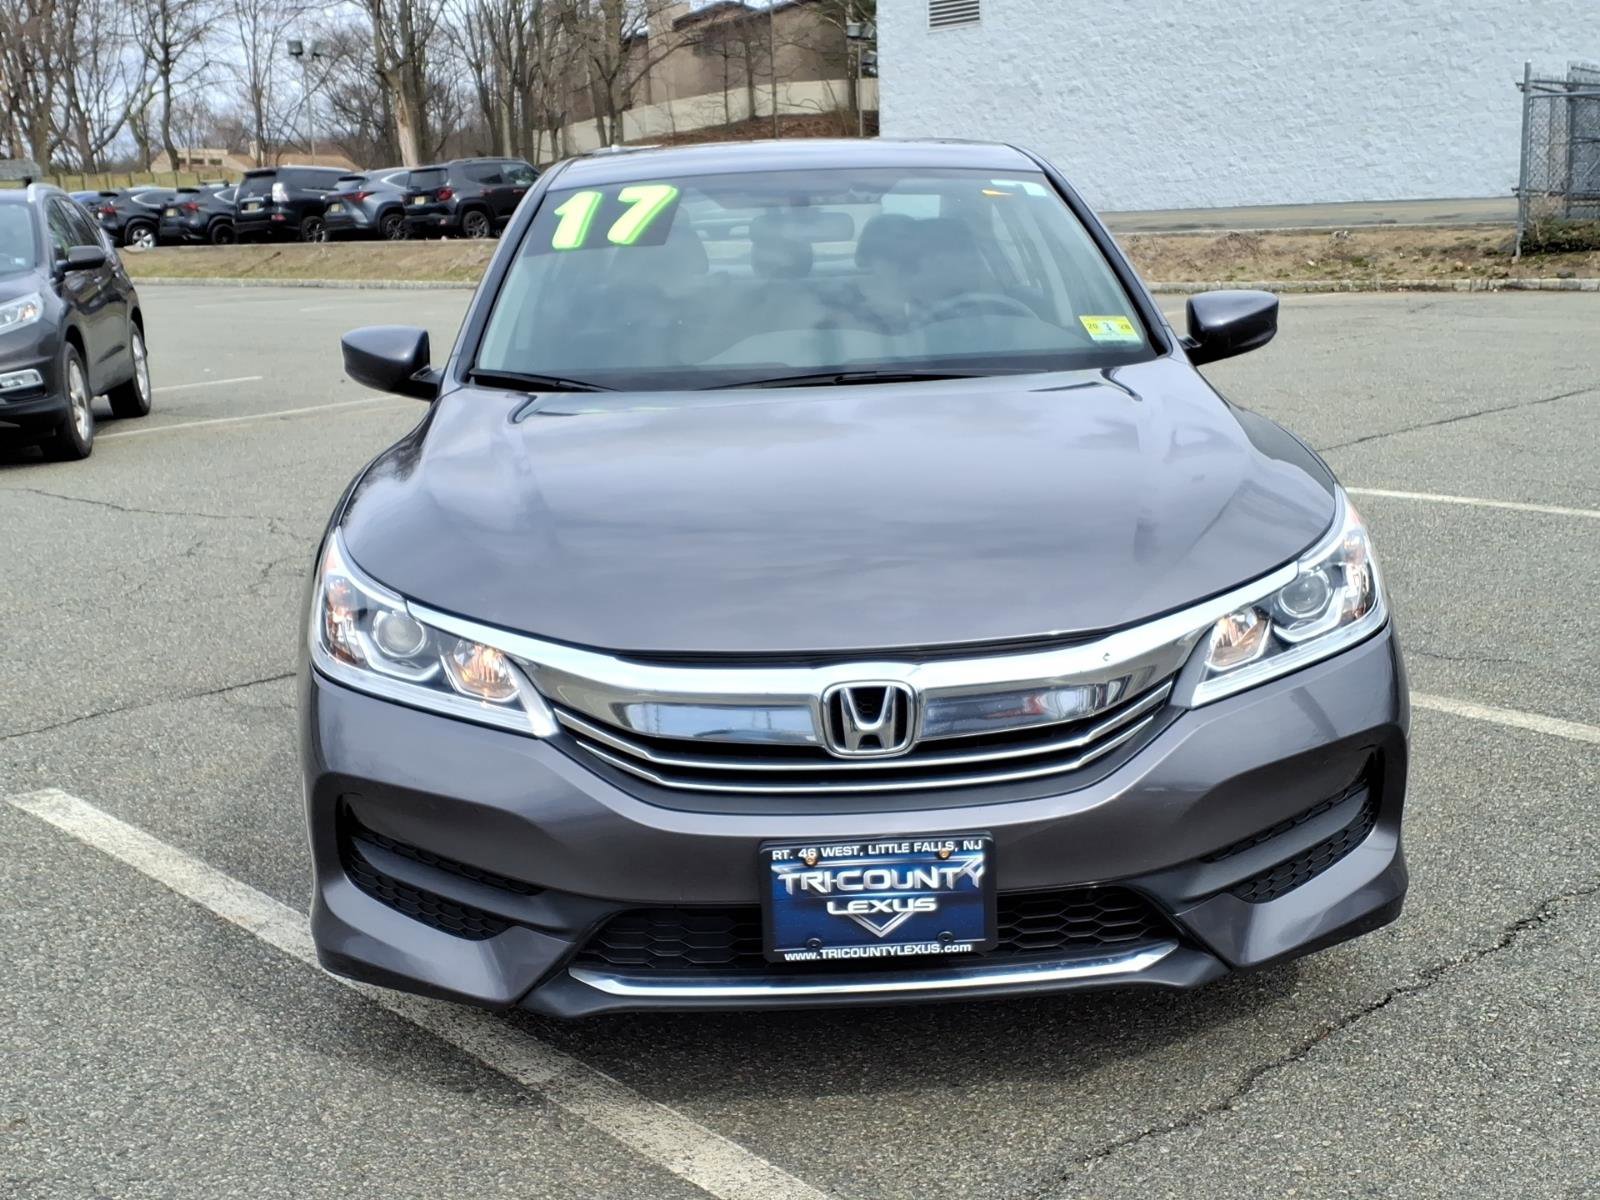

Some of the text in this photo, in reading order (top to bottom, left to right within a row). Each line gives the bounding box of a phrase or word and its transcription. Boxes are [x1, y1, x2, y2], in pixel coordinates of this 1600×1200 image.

[551, 184, 679, 250] 17
[772, 849, 794, 860] RT.
[798, 847, 817, 859] 46
[821, 845, 864, 857] WEST,
[868, 842, 910, 855] LITTLE
[963, 839, 983, 850] NJ
[826, 897, 938, 915] LEXUS
[784, 943, 972, 961] www.TRICOUNTYLEXUS.com
